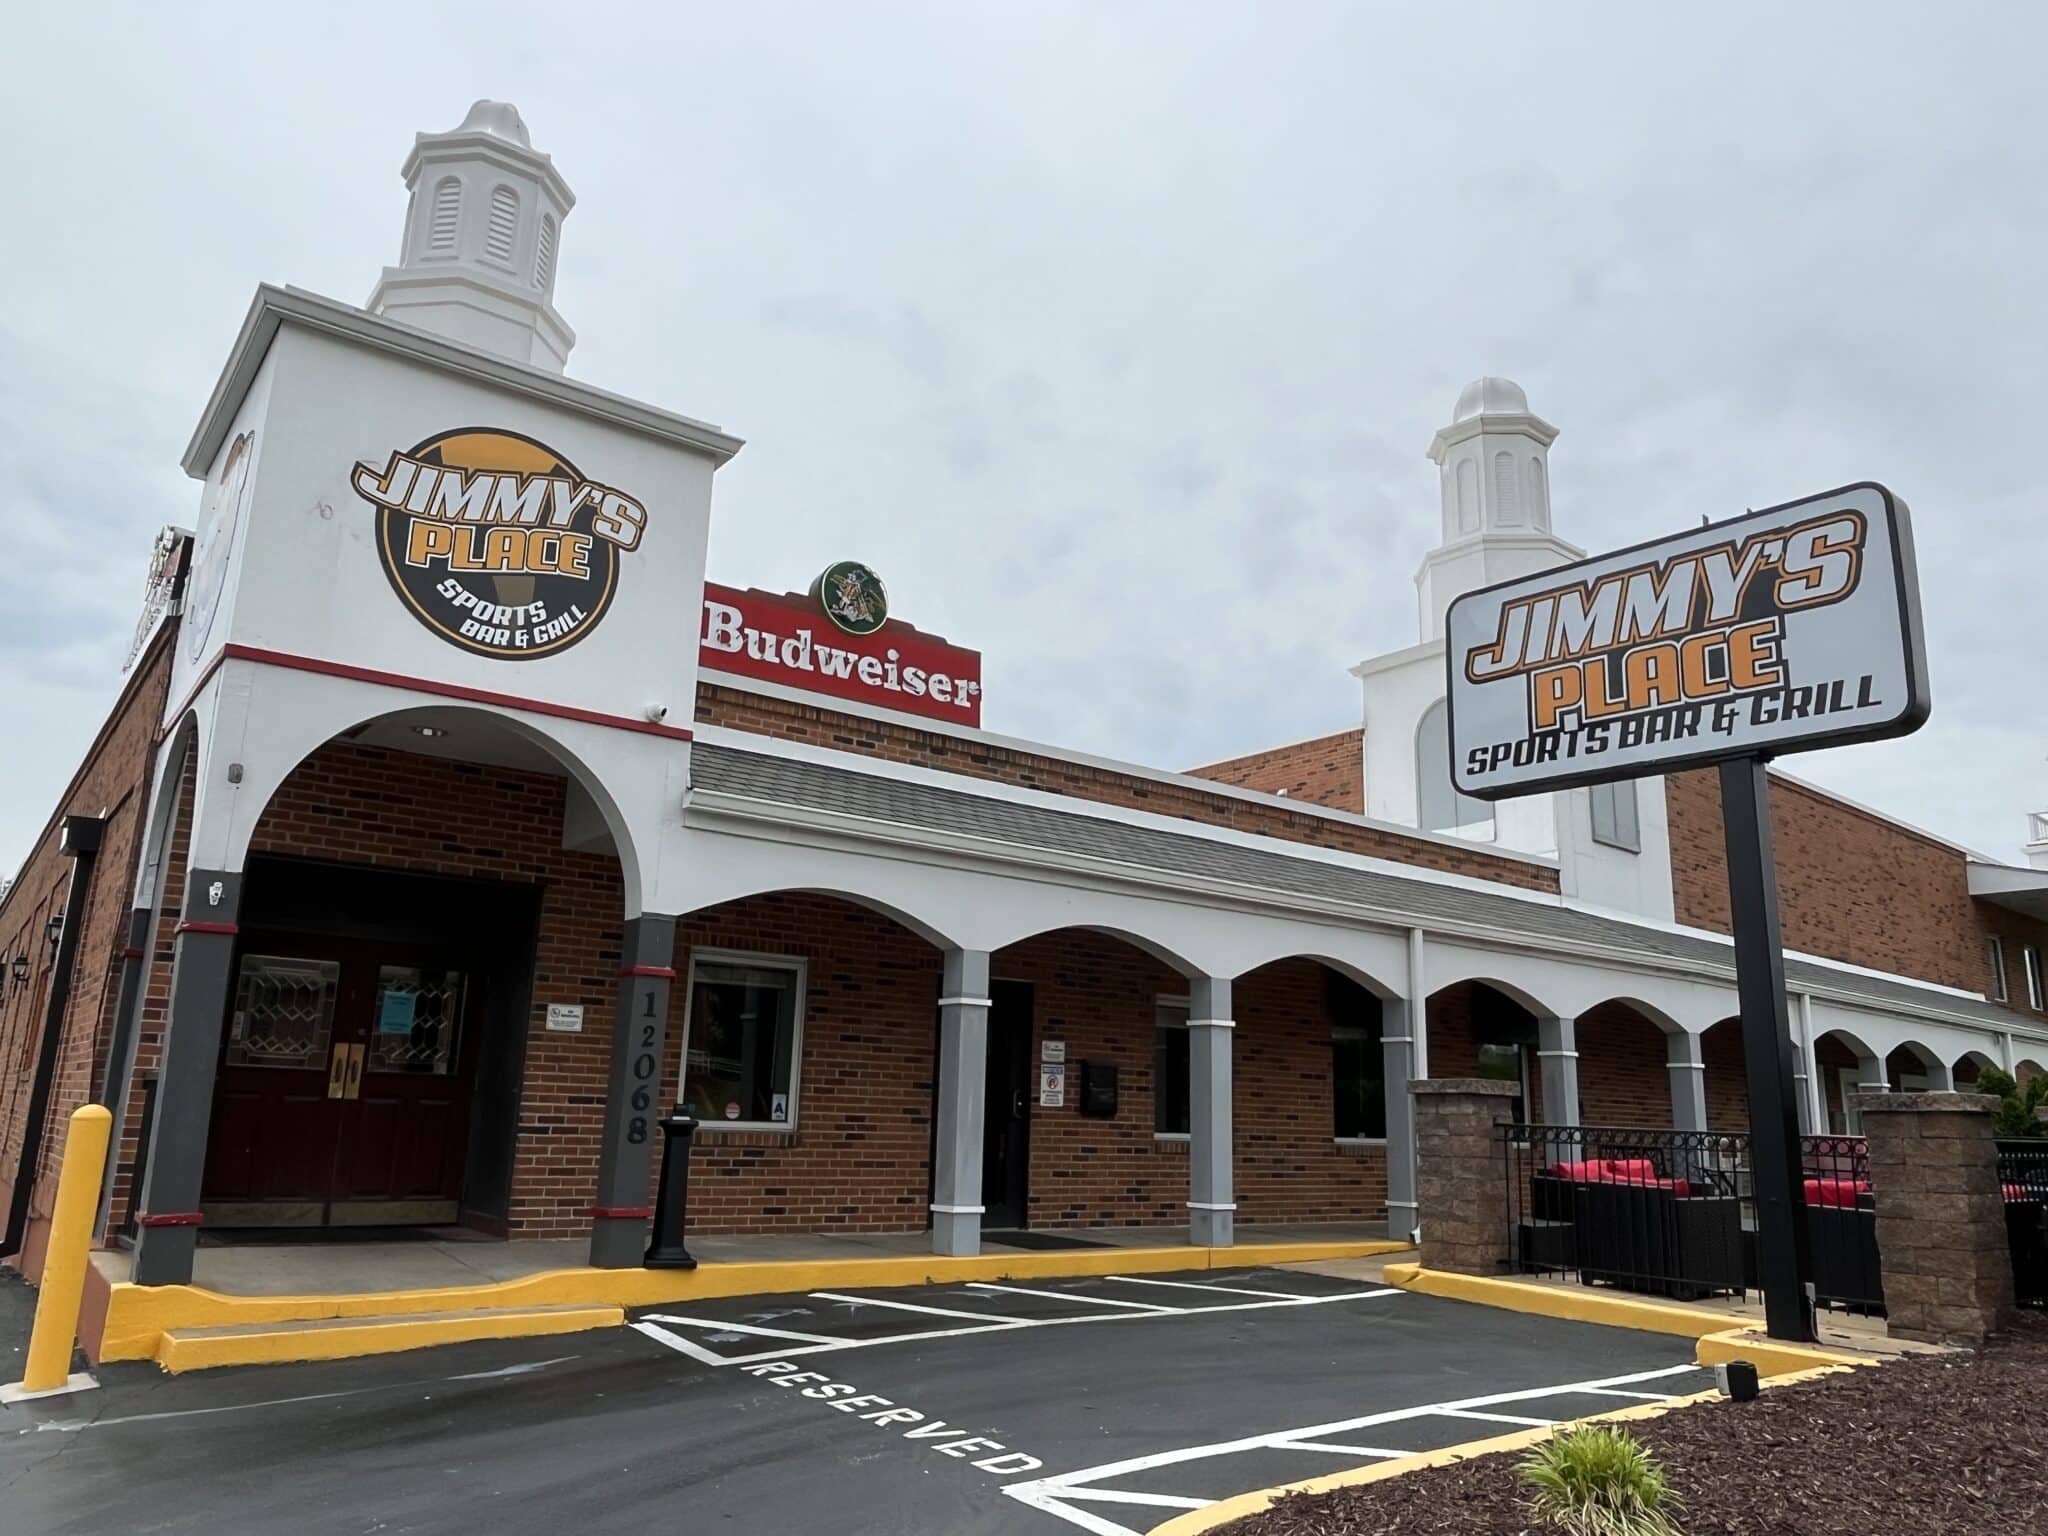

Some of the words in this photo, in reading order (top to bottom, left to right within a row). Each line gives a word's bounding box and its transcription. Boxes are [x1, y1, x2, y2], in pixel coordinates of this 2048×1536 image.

[353, 453, 646, 551] JIMMY'S
[406, 518, 592, 579] PLACE
[436, 578, 547, 625] SPORTS
[459, 619, 511, 646] BAR
[515, 629, 529, 648] &
[533, 604, 587, 644] GRILL
[1467, 510, 1865, 681] JIMMY'S
[701, 600, 980, 708] Budweiser
[1531, 617, 1785, 732] PLACE
[1466, 724, 1611, 776] SPORTS
[1618, 701, 1702, 749] BAR
[1711, 702, 1740, 736] &
[1750, 675, 1882, 726] GRILL
[627, 991, 656, 1145] 12068
[740, 1361, 1043, 1474] RESERVED
